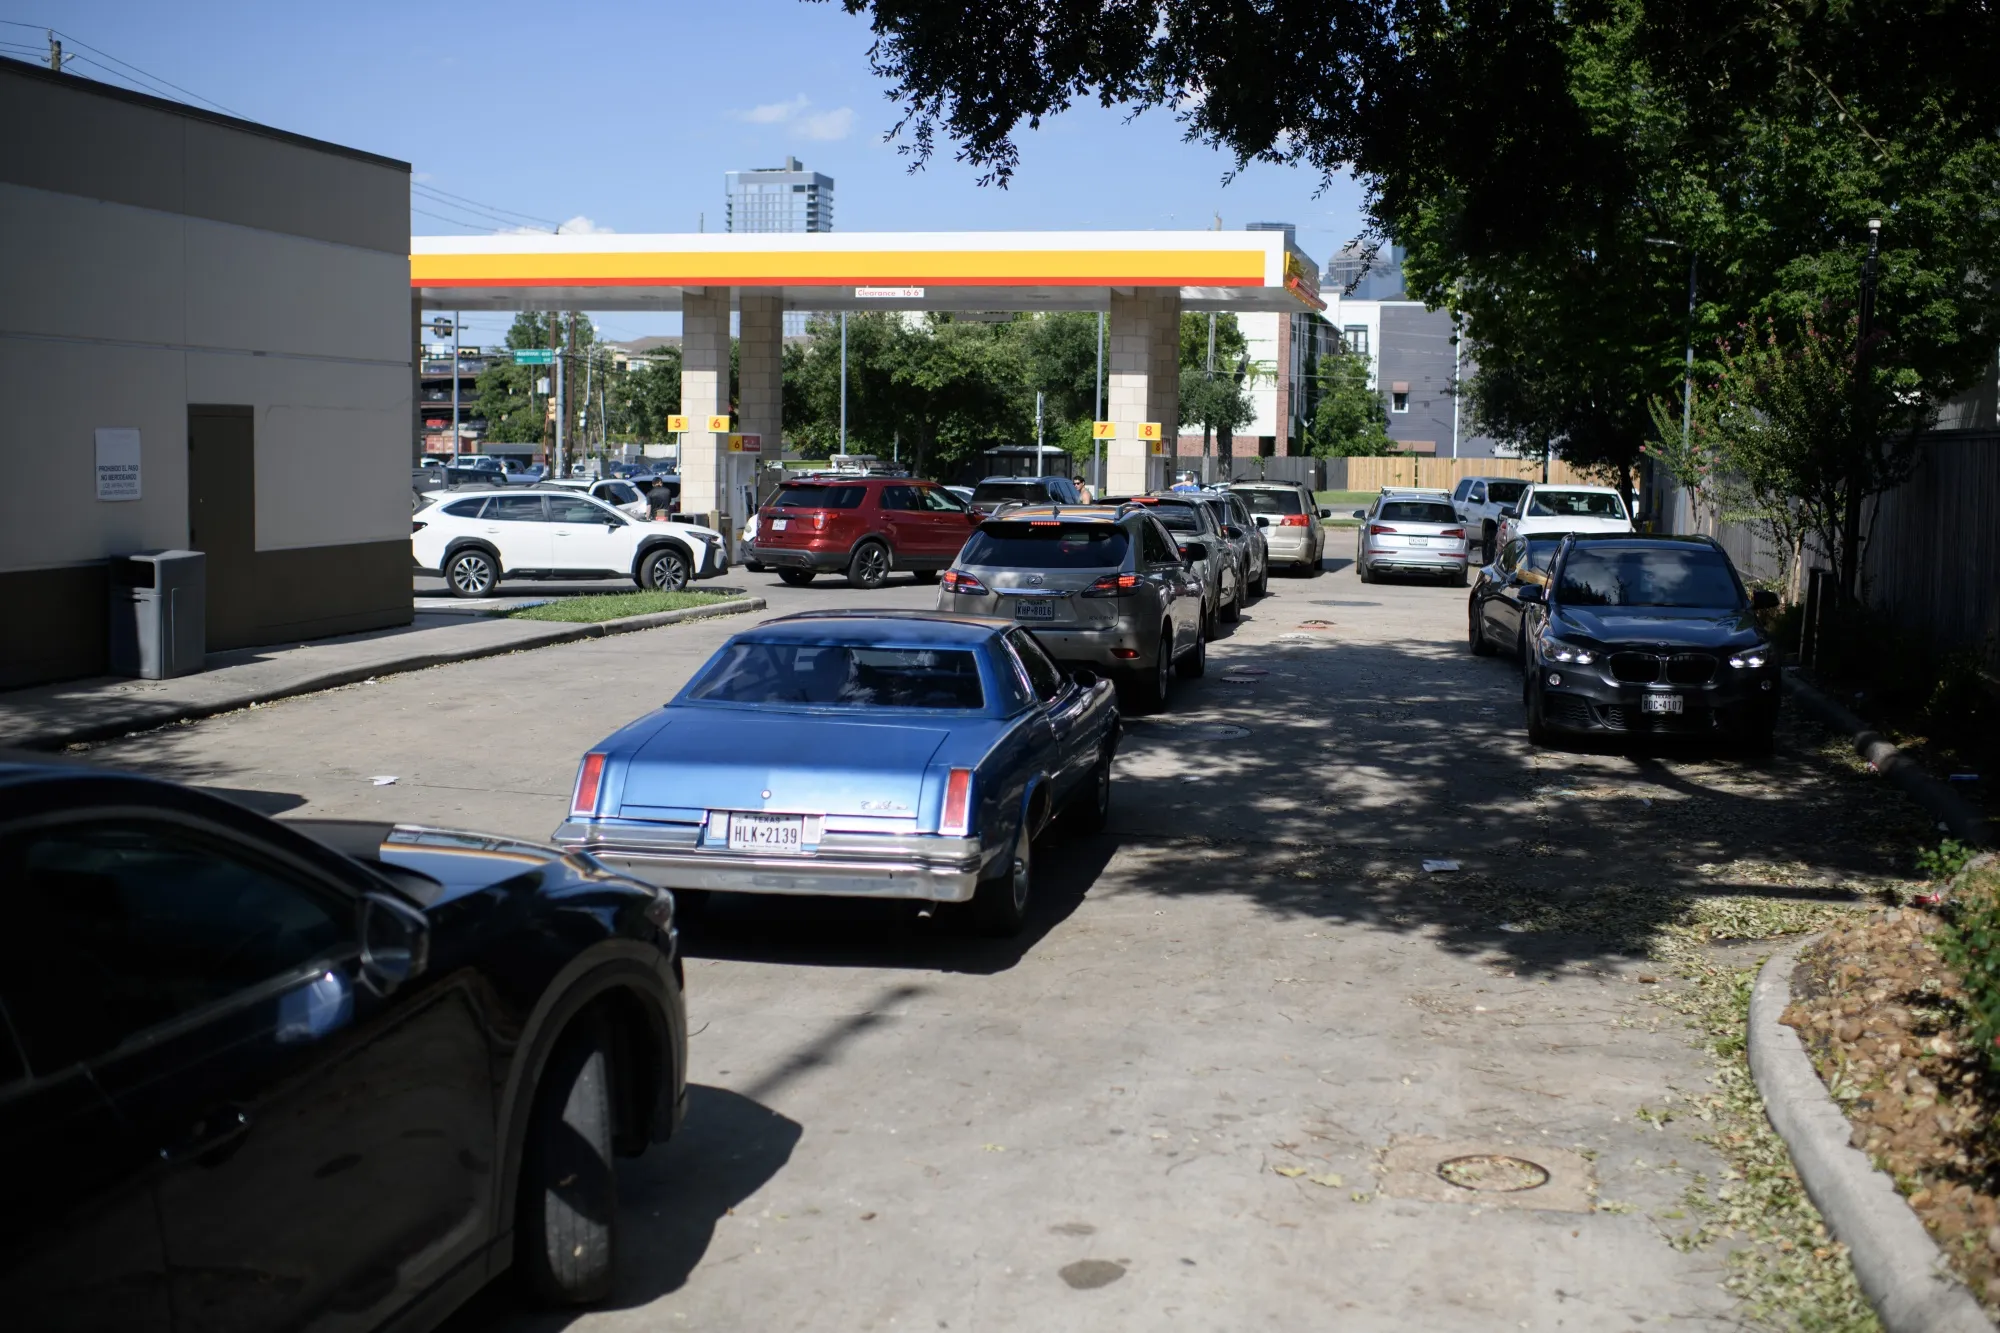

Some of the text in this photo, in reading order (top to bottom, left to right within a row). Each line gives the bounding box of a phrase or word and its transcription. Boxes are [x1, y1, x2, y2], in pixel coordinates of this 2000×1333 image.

[857, 289, 896, 297] Clearance
[674, 418, 682, 429] 5
[713, 418, 721, 429] 6
[1099, 424, 1108, 435] 7
[1144, 425, 1153, 436] 8
[734, 440, 740, 449] 6
[1155, 442, 1161, 451] 8
[122, 464, 127, 472] EL
[128, 464, 139, 472] PASO
[752, 815, 781, 824] TEXAS
